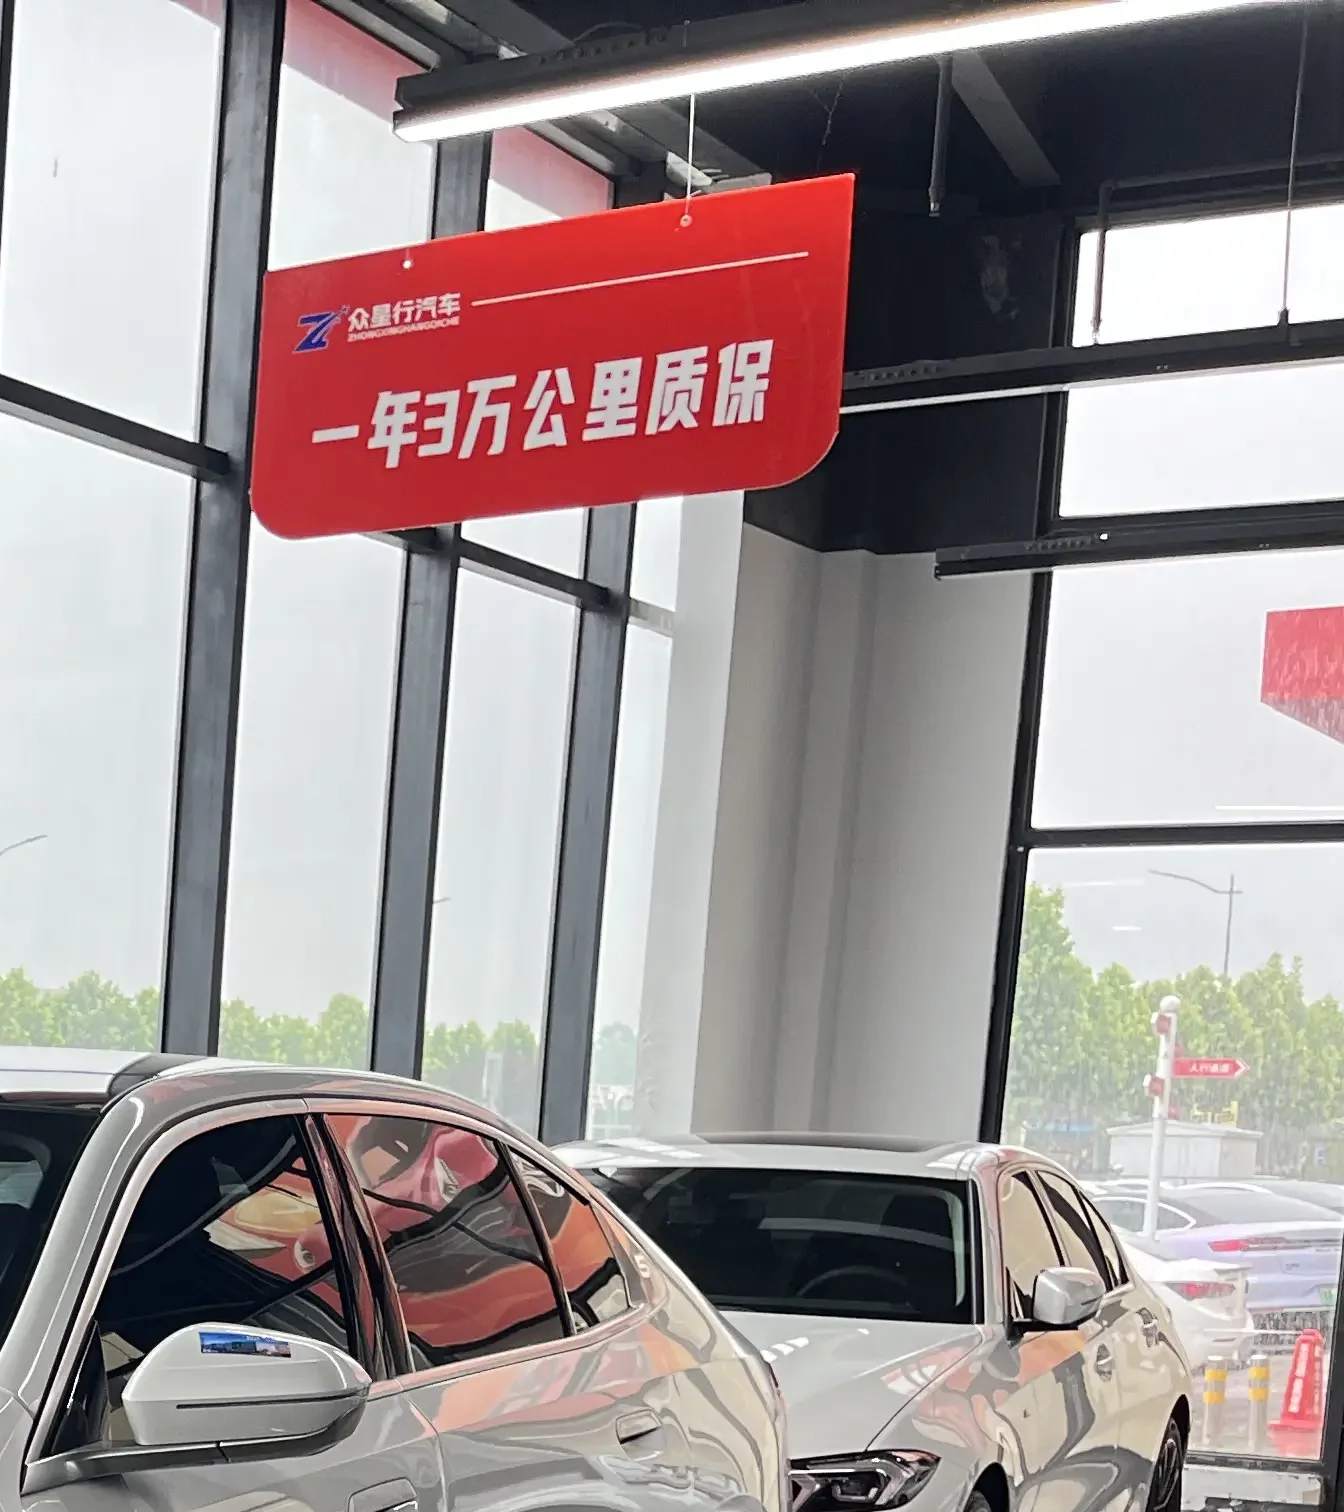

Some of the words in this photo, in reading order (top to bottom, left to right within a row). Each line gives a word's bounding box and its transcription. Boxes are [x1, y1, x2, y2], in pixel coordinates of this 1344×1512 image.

[347, 292, 461, 333] 众星行汽车
[311, 338, 775, 470] 一年3万公里质保
